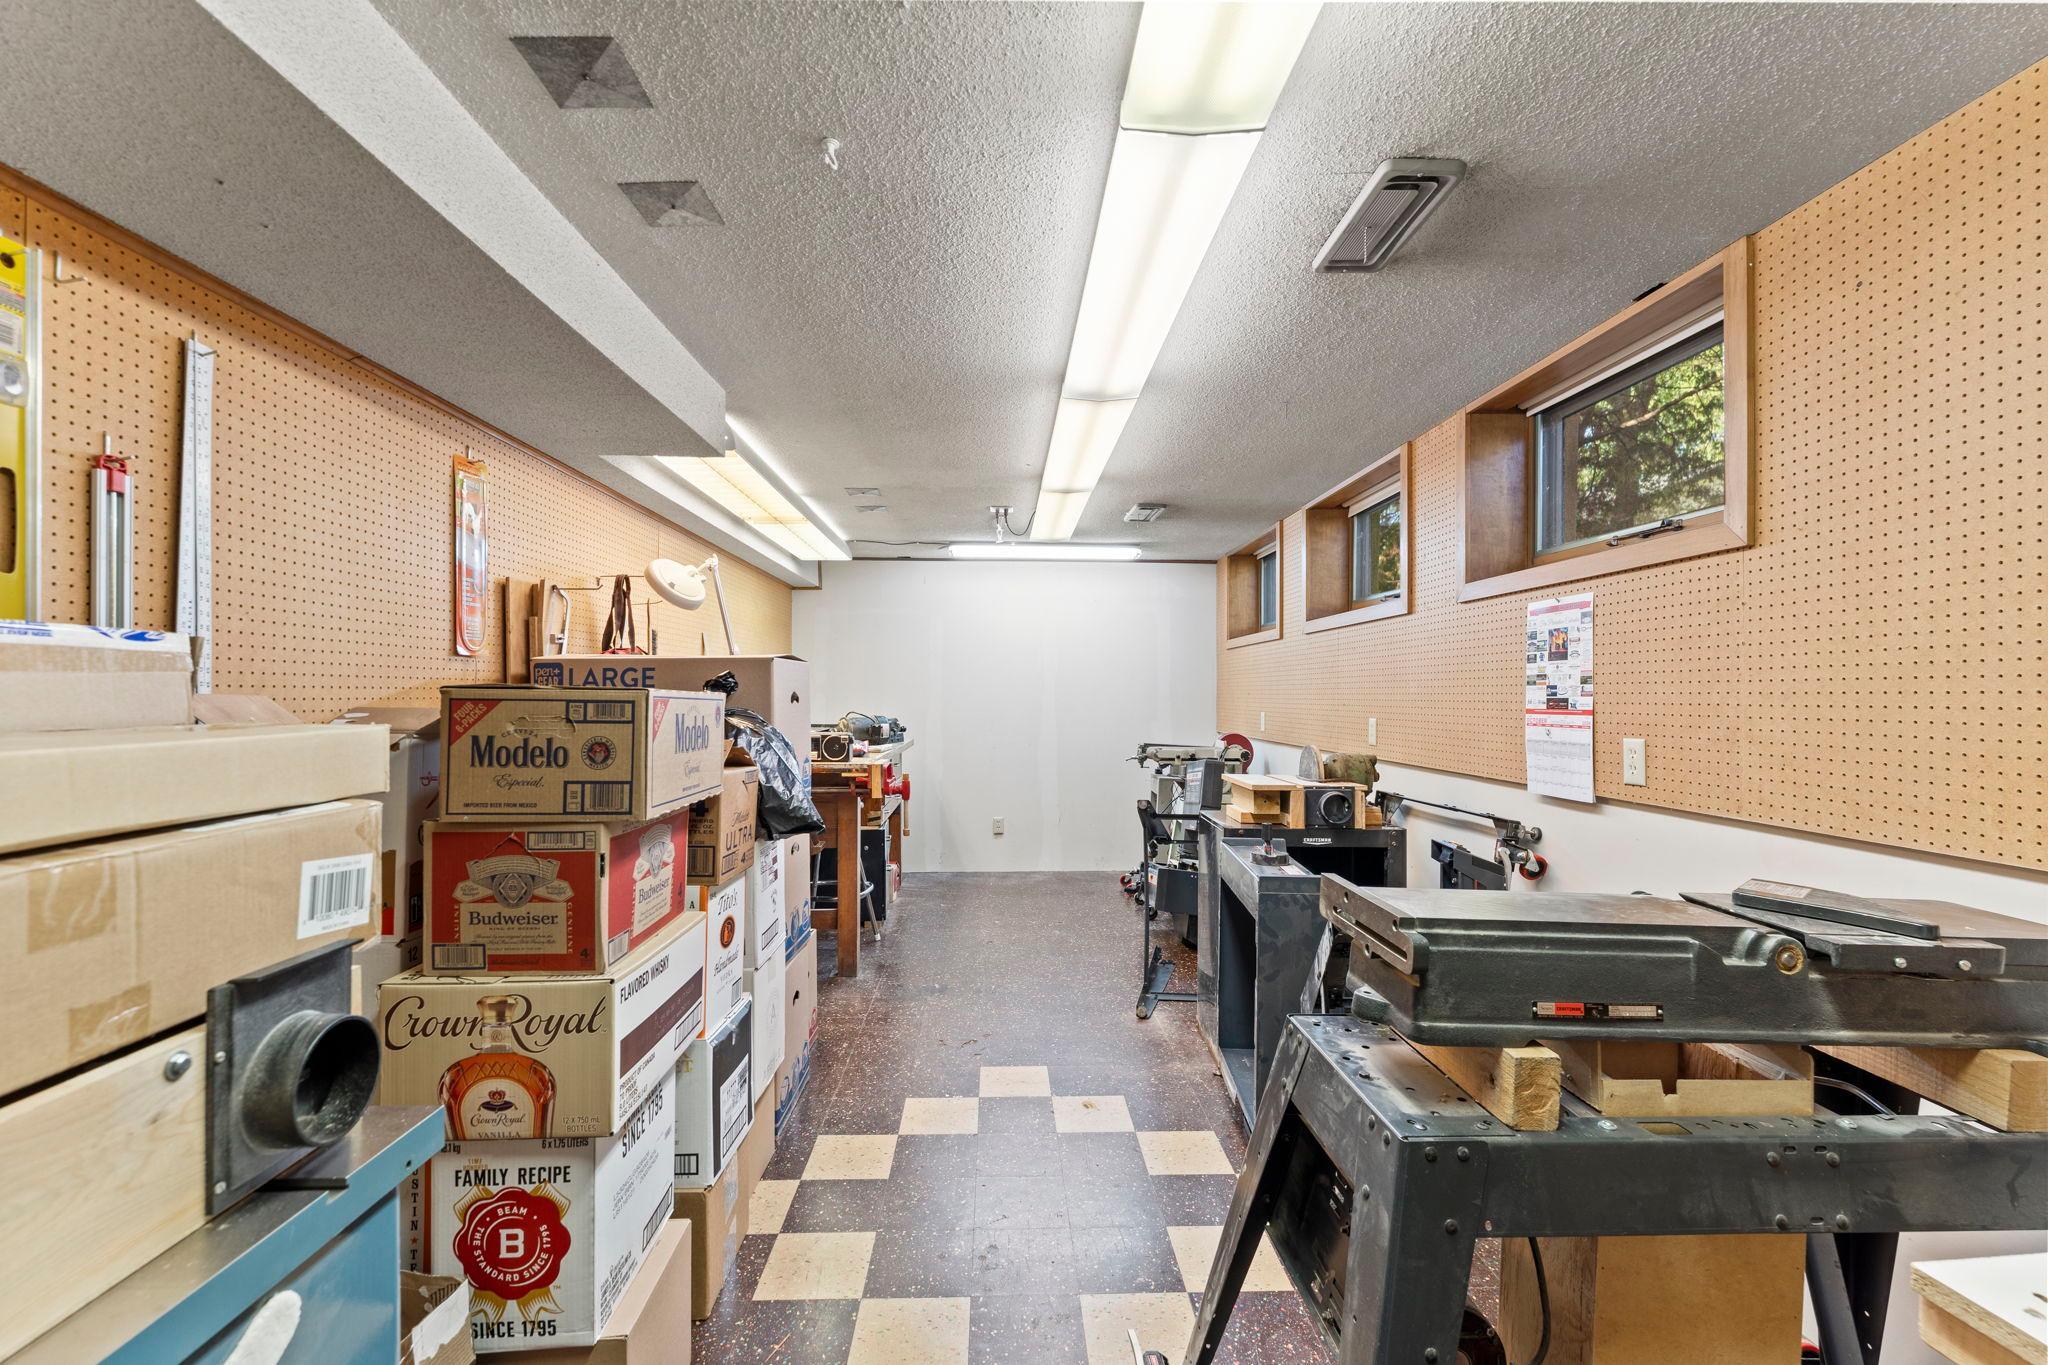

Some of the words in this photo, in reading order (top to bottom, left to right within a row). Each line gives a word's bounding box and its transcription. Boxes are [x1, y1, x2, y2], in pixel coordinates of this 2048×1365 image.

[568, 667, 656, 688] LARGE
[454, 702, 475, 721] FOUR
[455, 703, 487, 733] 6-PACKS
[675, 713, 710, 755] Modelo
[469, 735, 569, 769] Modelo
[726, 824, 752, 851] ULTRA
[638, 877, 671, 904] Budweiser
[717, 888, 738, 916] Tito's
[689, 901, 695, 909] A
[468, 911, 559, 926] Budweiser
[408, 947, 418, 963] 12
[580, 948, 589, 958] 4
[620, 970, 650, 1004] FLAVORED
[650, 954, 670, 982] WHISKY
[384, 996, 483, 1051] Crown
[508, 994, 606, 1054] Royal
[470, 1114, 497, 1127] Crown
[495, 1113, 525, 1127] Royal
[622, 1112, 645, 1158] SINCE
[648, 1088, 663, 1126] 1795
[453, 1142, 461, 1155] kg
[541, 1141, 547, 1150] 6
[553, 1140, 566, 1149] 1.75
[566, 1138, 589, 1148] LITERS
[454, 1168, 508, 1187] FAMILY
[517, 1165, 571, 1185] RECIPE
[496, 1206, 528, 1216] BEAM
[472, 1226, 484, 1246] THE
[499, 1228, 525, 1259] B
[539, 1224, 551, 1249] 1795
[473, 1250, 520, 1282] STANDARD
[523, 1252, 550, 1278] SINCE
[471, 1320, 515, 1340] SINCE
[521, 1319, 557, 1337] 1795
